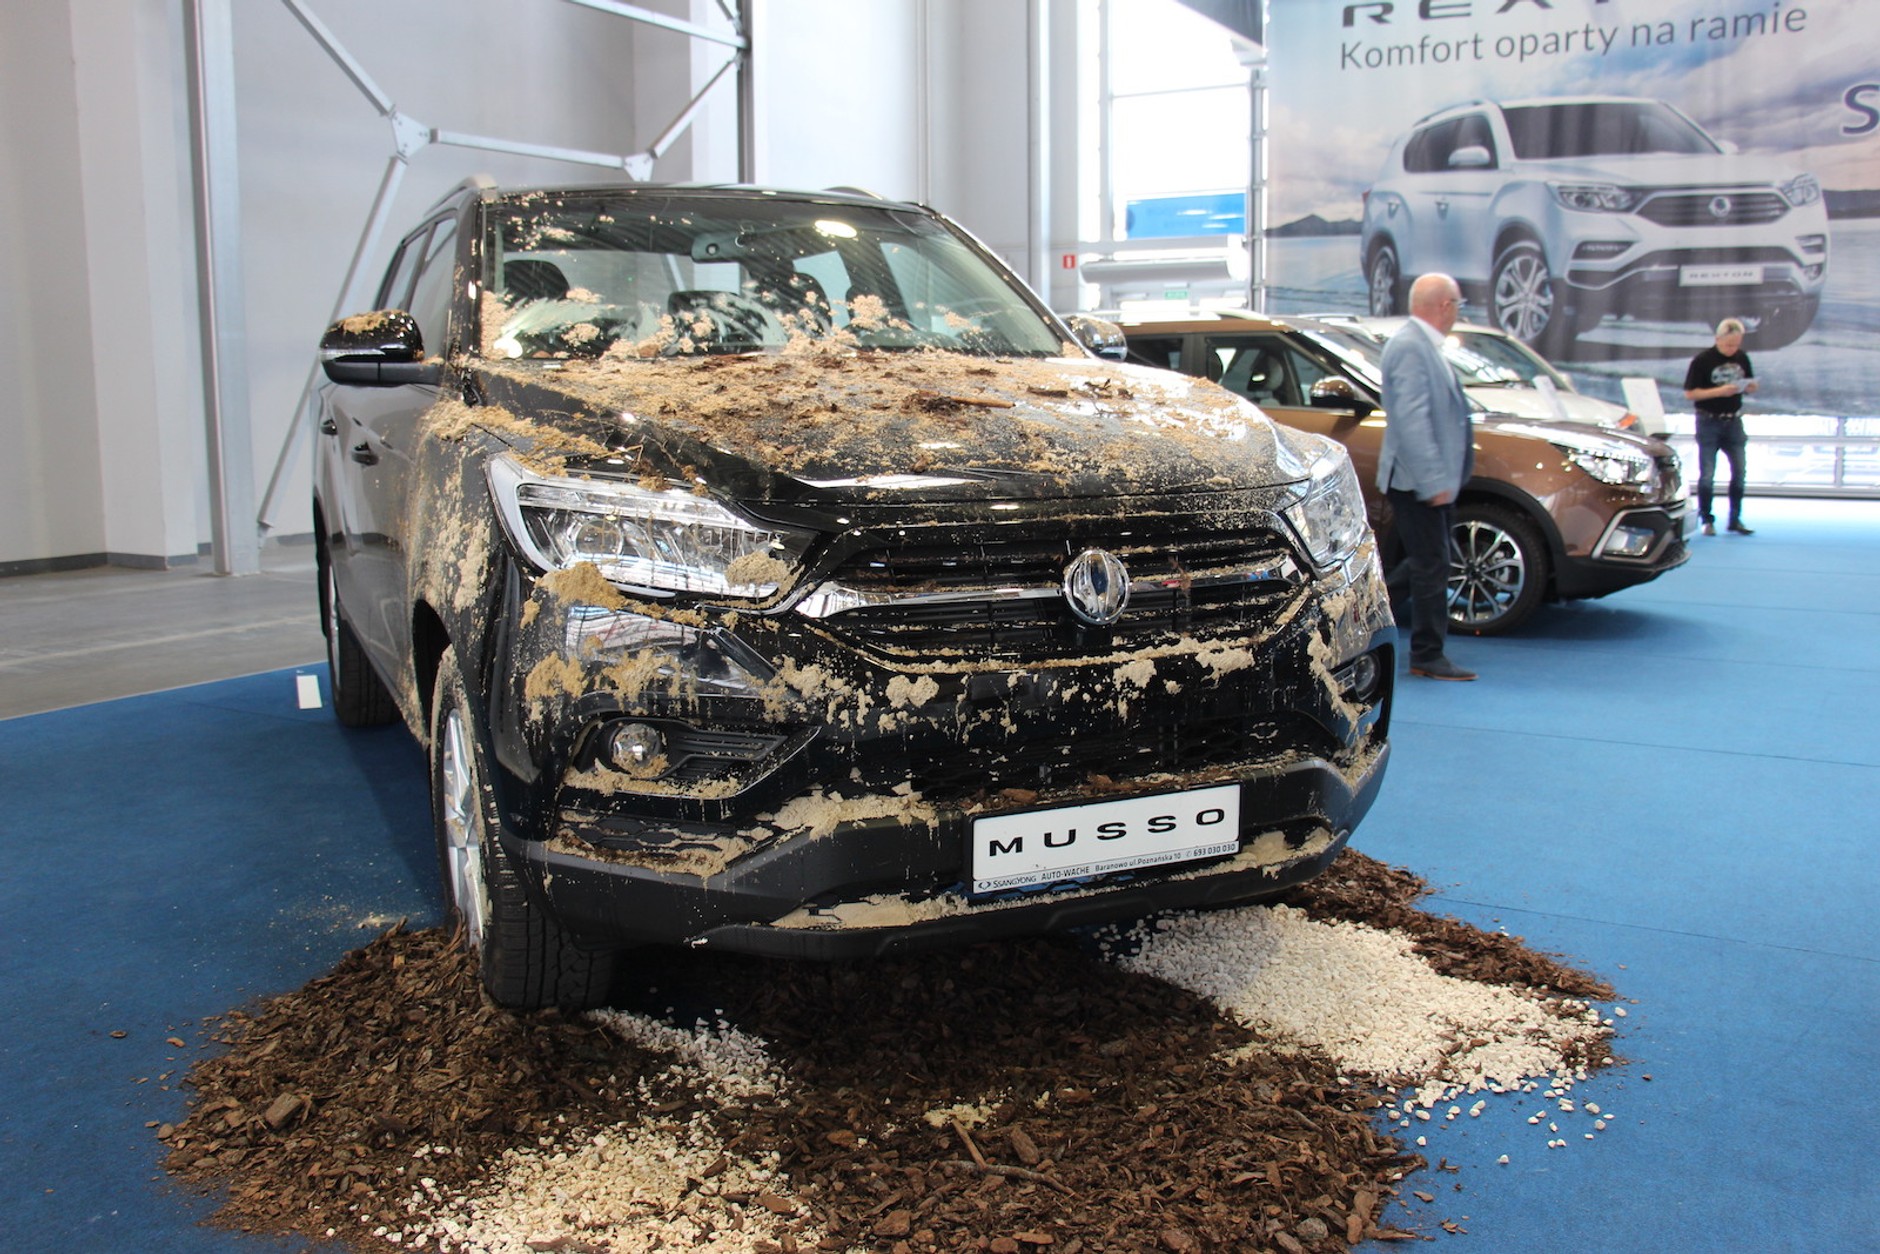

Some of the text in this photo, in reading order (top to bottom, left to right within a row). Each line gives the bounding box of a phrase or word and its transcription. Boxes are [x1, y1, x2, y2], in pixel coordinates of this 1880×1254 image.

[1340, 2, 1808, 70] Komfort oparty na ramie
[989, 808, 1225, 857] MUSSO
[1041, 866, 1090, 881] AUTO-WACHE
[1095, 861, 1128, 872] Baranowo
[1193, 848, 1207, 857] 693
[1207, 845, 1222, 855] 030
[1222, 843, 1236, 853] 030
